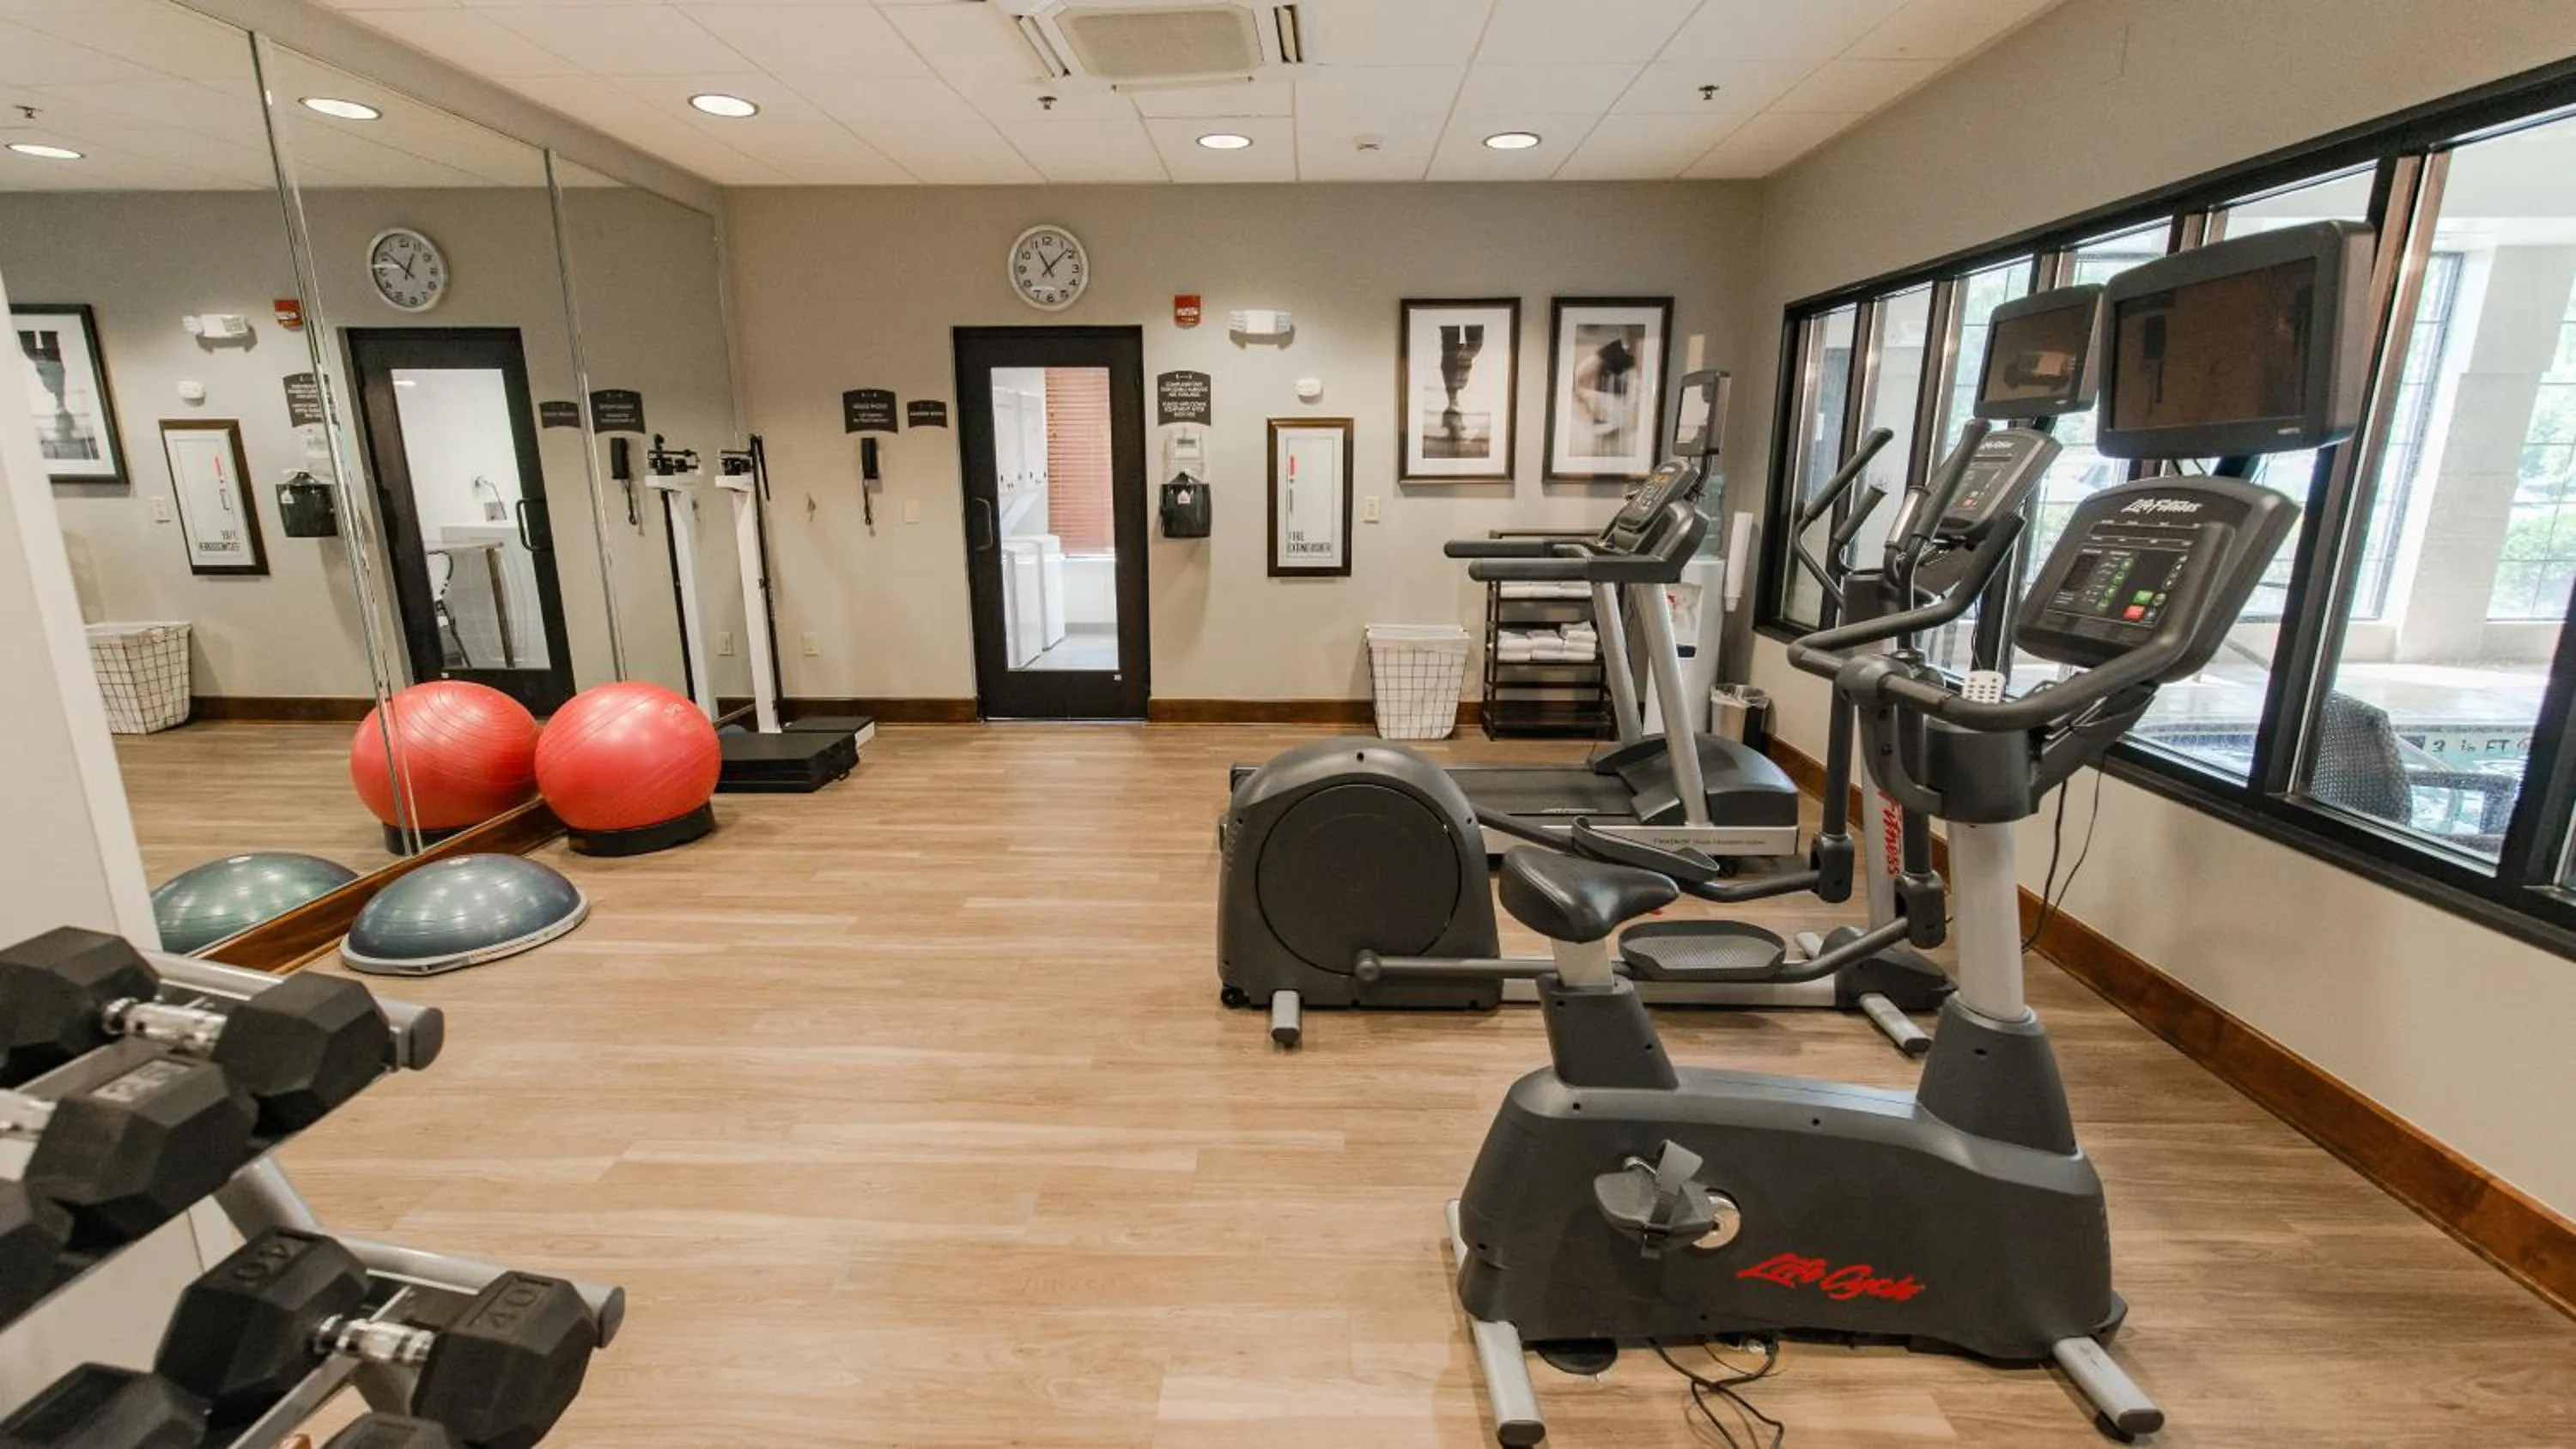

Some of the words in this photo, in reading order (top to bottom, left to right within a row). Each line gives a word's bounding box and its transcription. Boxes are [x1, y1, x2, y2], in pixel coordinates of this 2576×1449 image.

[1042, 236, 1053, 246] 12
[1022, 251, 1031, 260] 10
[1071, 264, 1079, 274] 3
[1068, 278, 1078, 287] 4
[1033, 289, 1042, 300] 7
[2485, 739, 2511, 752] FT
